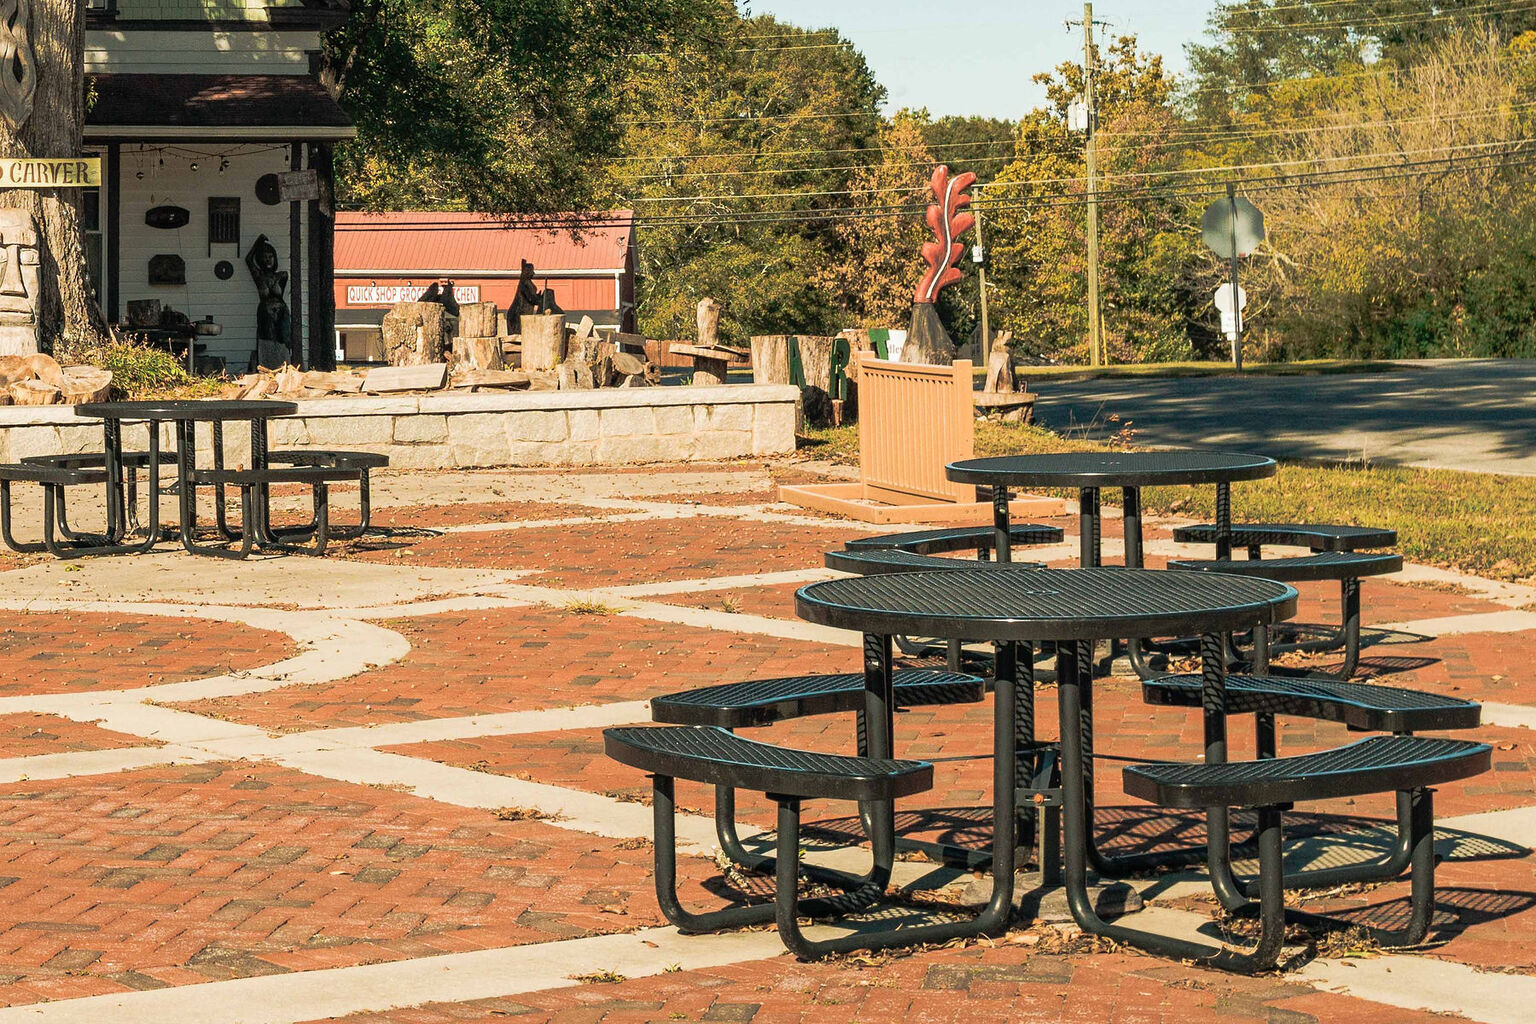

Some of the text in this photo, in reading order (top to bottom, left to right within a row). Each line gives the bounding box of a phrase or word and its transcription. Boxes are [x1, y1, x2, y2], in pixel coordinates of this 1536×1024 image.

[9, 161, 92, 184] CARVER
[349, 287, 373, 302] QUICK
[375, 287, 397, 302] SHOP
